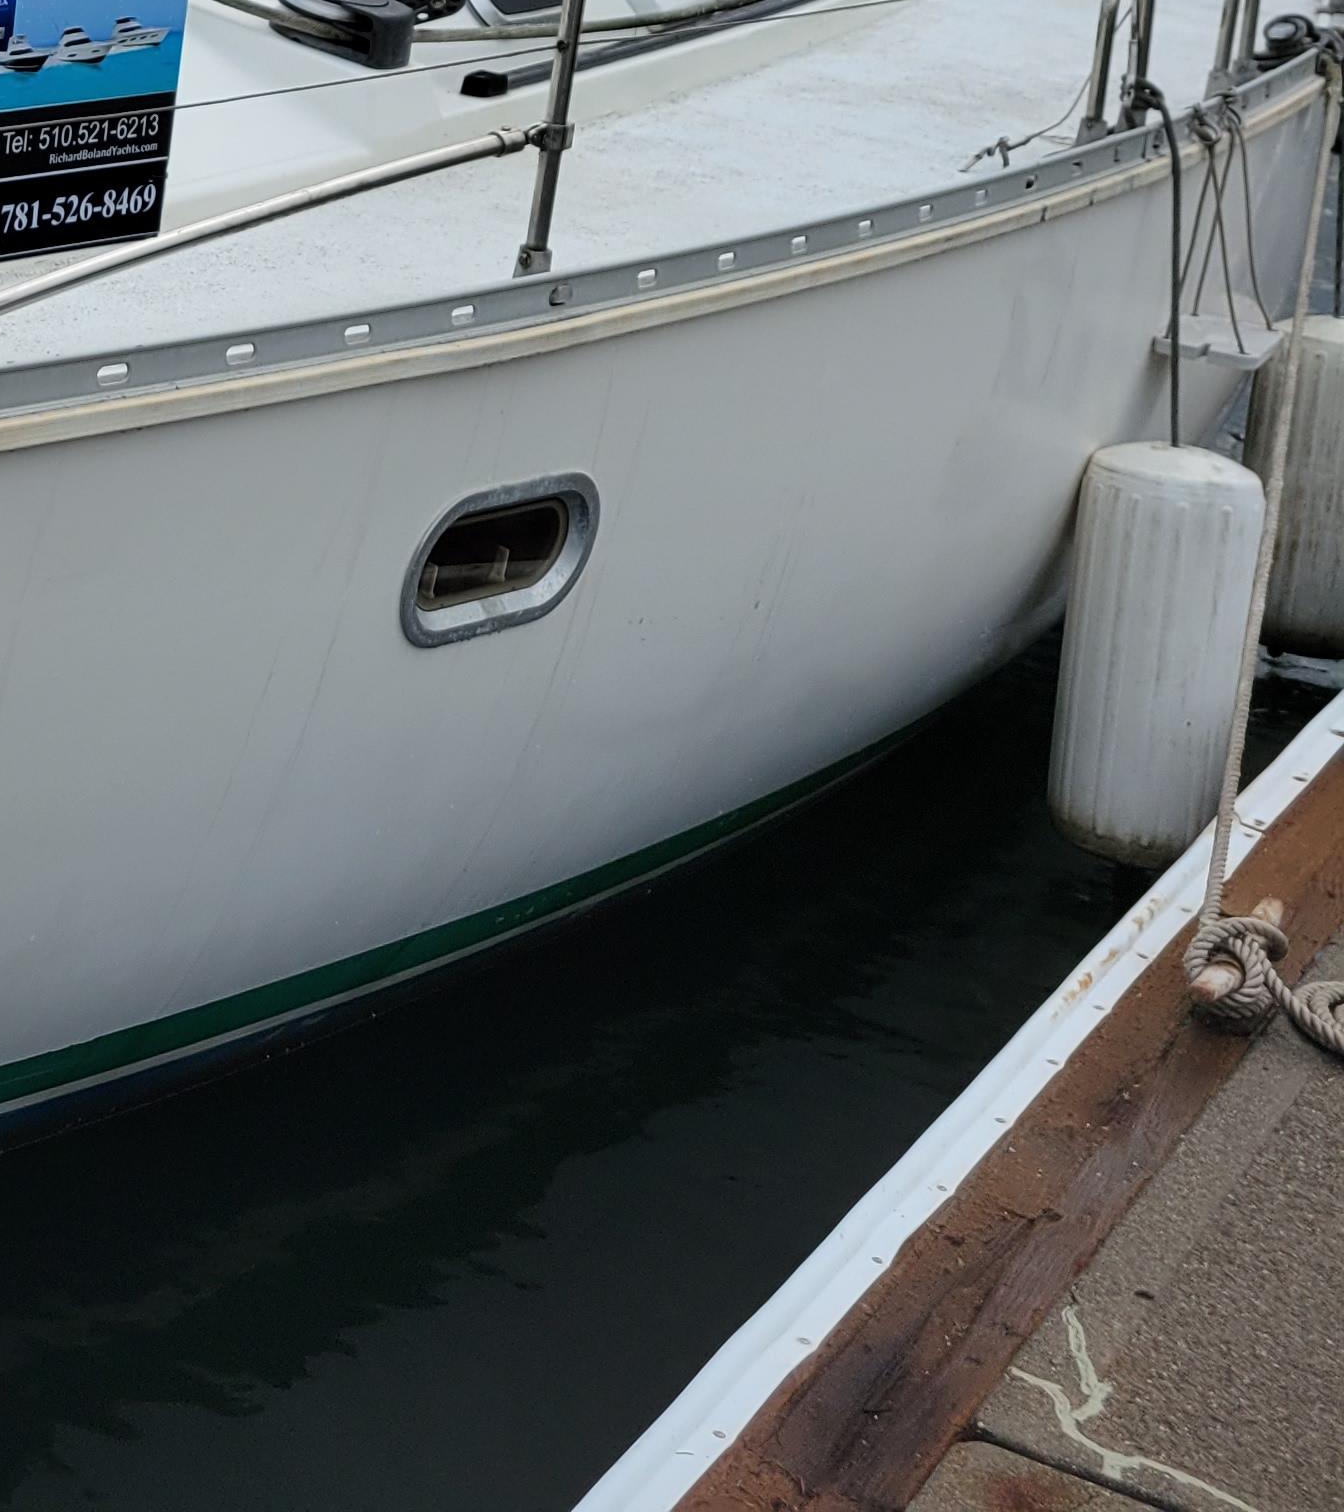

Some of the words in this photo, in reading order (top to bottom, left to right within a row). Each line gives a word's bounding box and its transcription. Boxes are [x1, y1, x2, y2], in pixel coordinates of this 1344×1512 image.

[3, 129, 33, 155] Tel:
[38, 113, 160, 150] 510.521-6213
[49, 142, 159, 165] RichardBolandYachts.com
[1, 184, 156, 234] 781-526-8469
